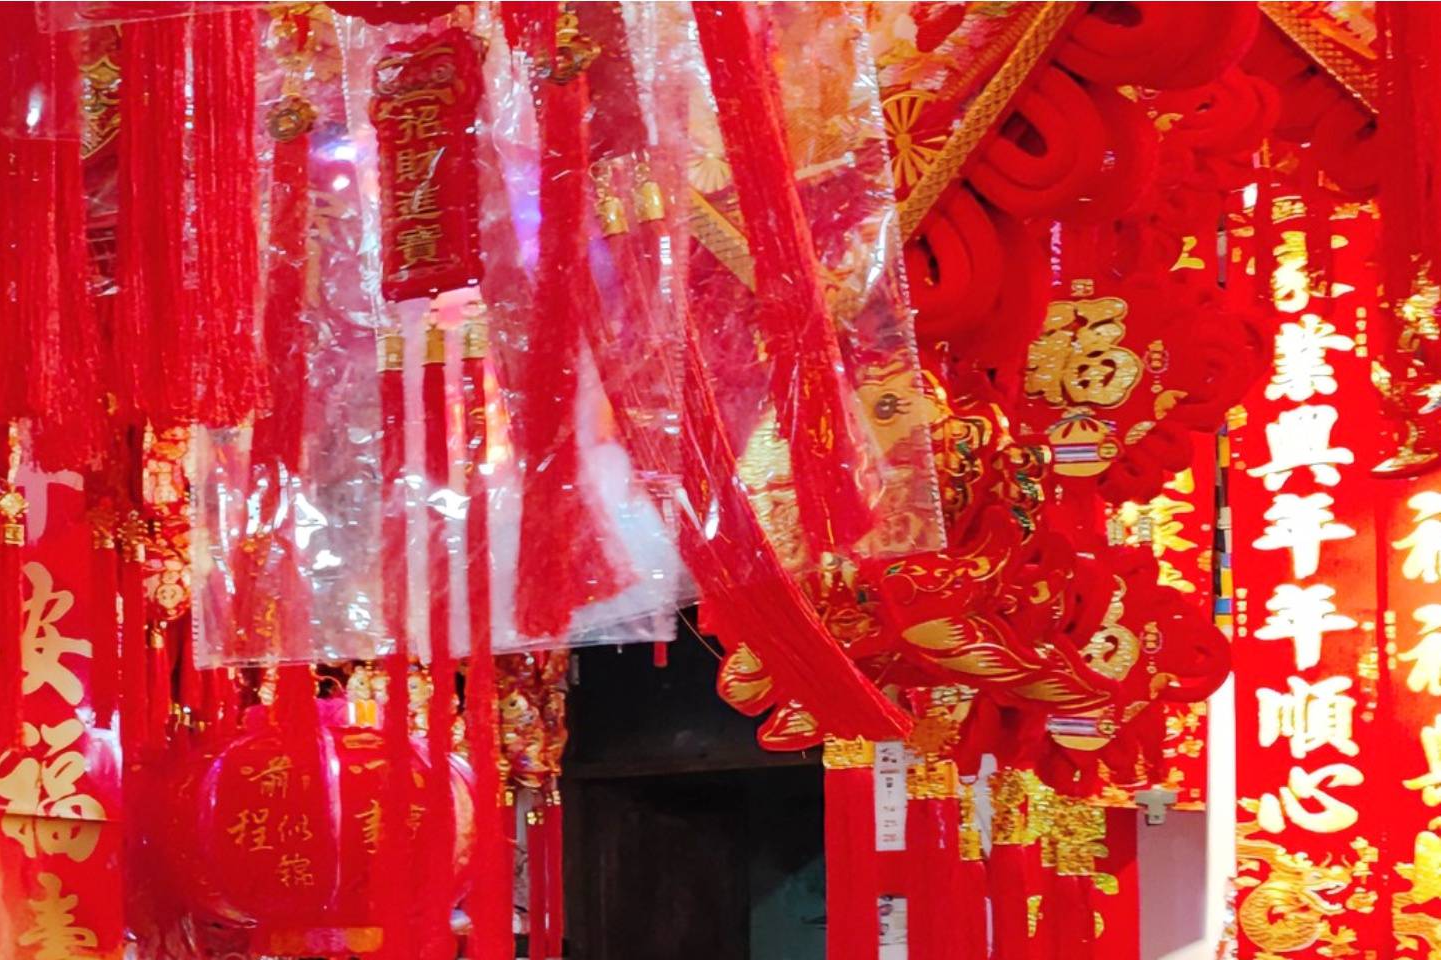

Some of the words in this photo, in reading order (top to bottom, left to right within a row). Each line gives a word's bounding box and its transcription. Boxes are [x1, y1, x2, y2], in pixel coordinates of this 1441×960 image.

[395, 104, 443, 264] 招財進寶
[1025, 297, 1146, 410] 福
